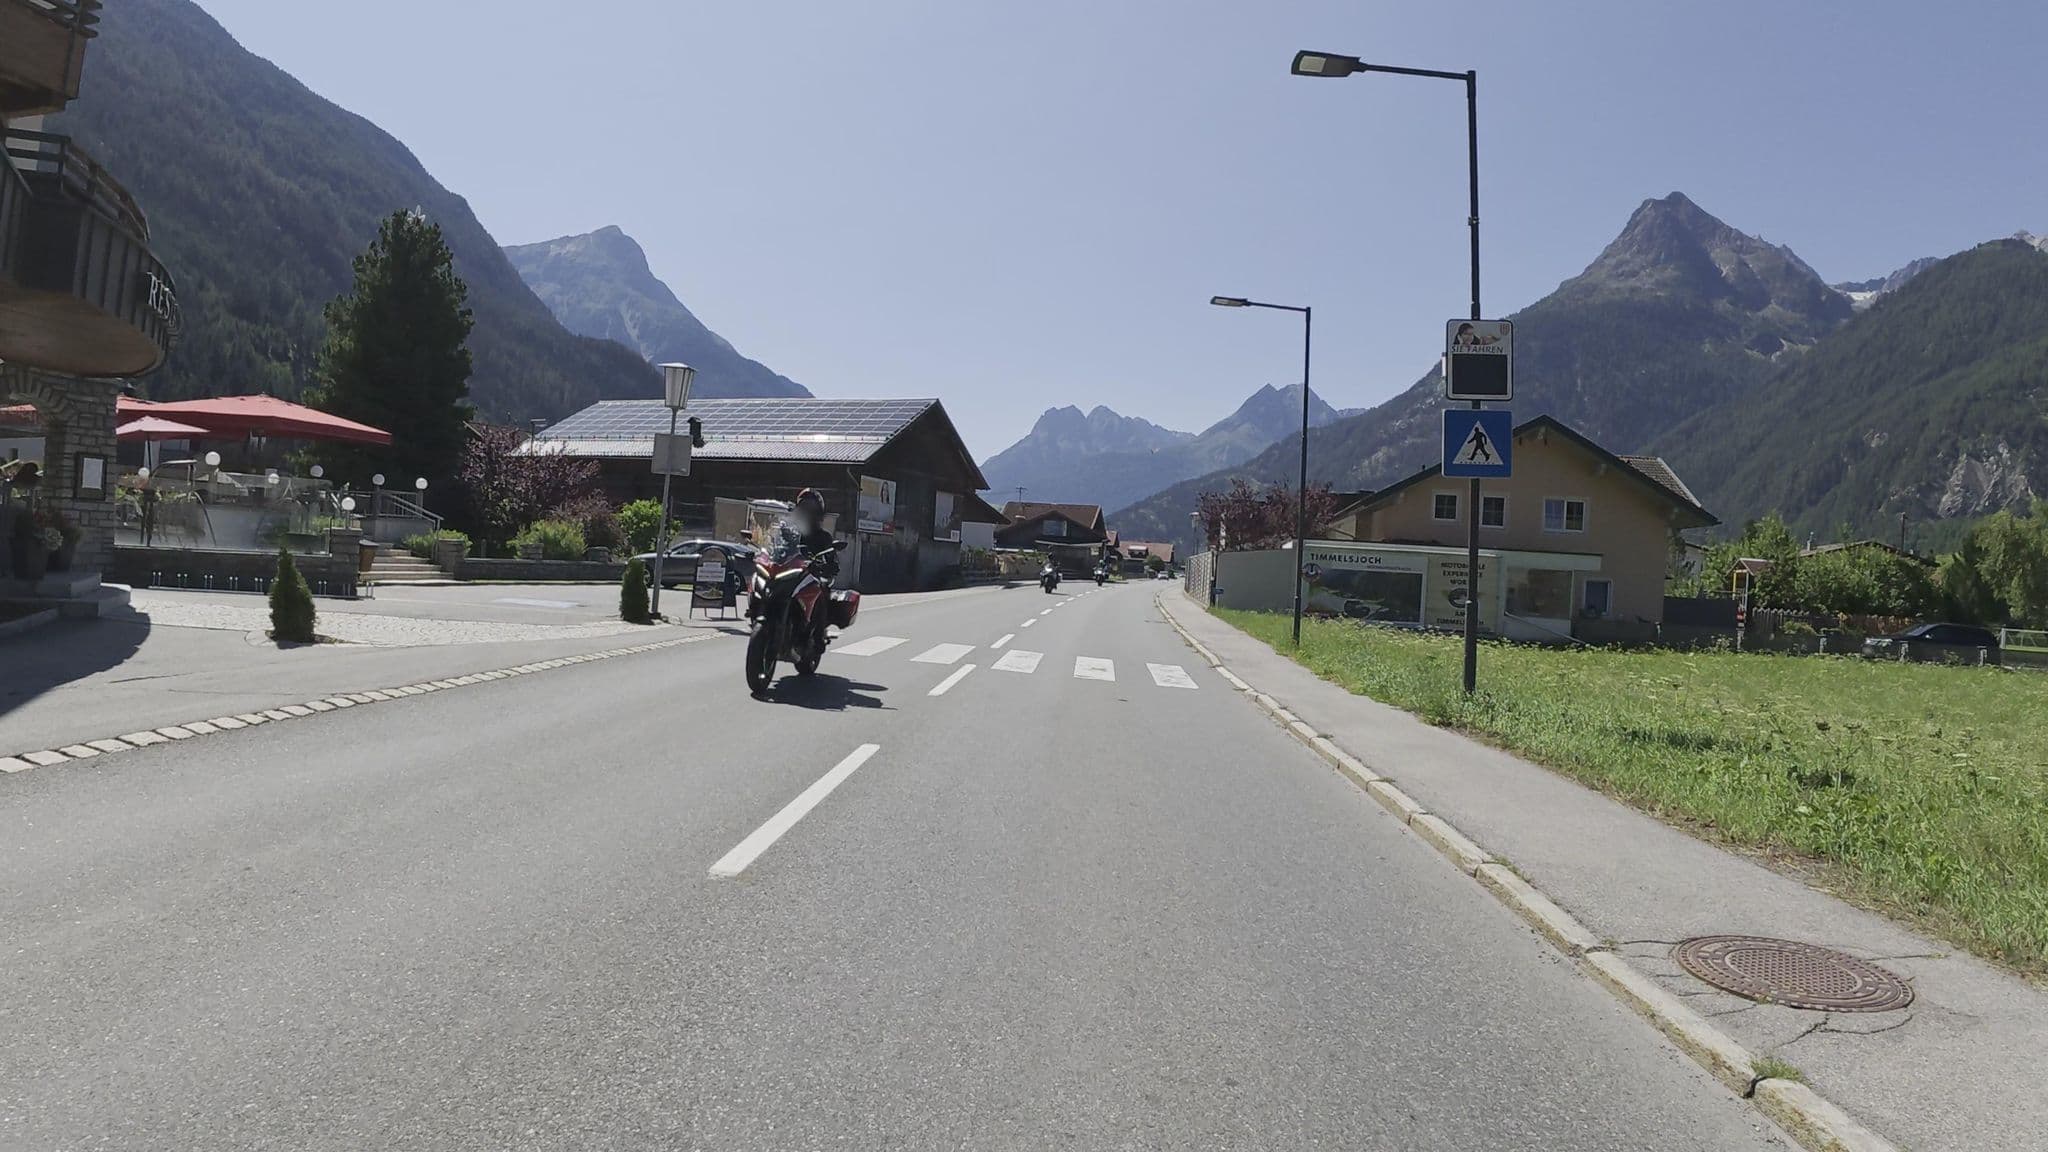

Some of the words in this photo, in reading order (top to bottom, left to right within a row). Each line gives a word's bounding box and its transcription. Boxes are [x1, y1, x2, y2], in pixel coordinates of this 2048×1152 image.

[1451, 344, 1463, 353] SIE
[1466, 344, 1503, 353] FAHREN
[1310, 553, 1382, 564] TIMMELSJOCH
